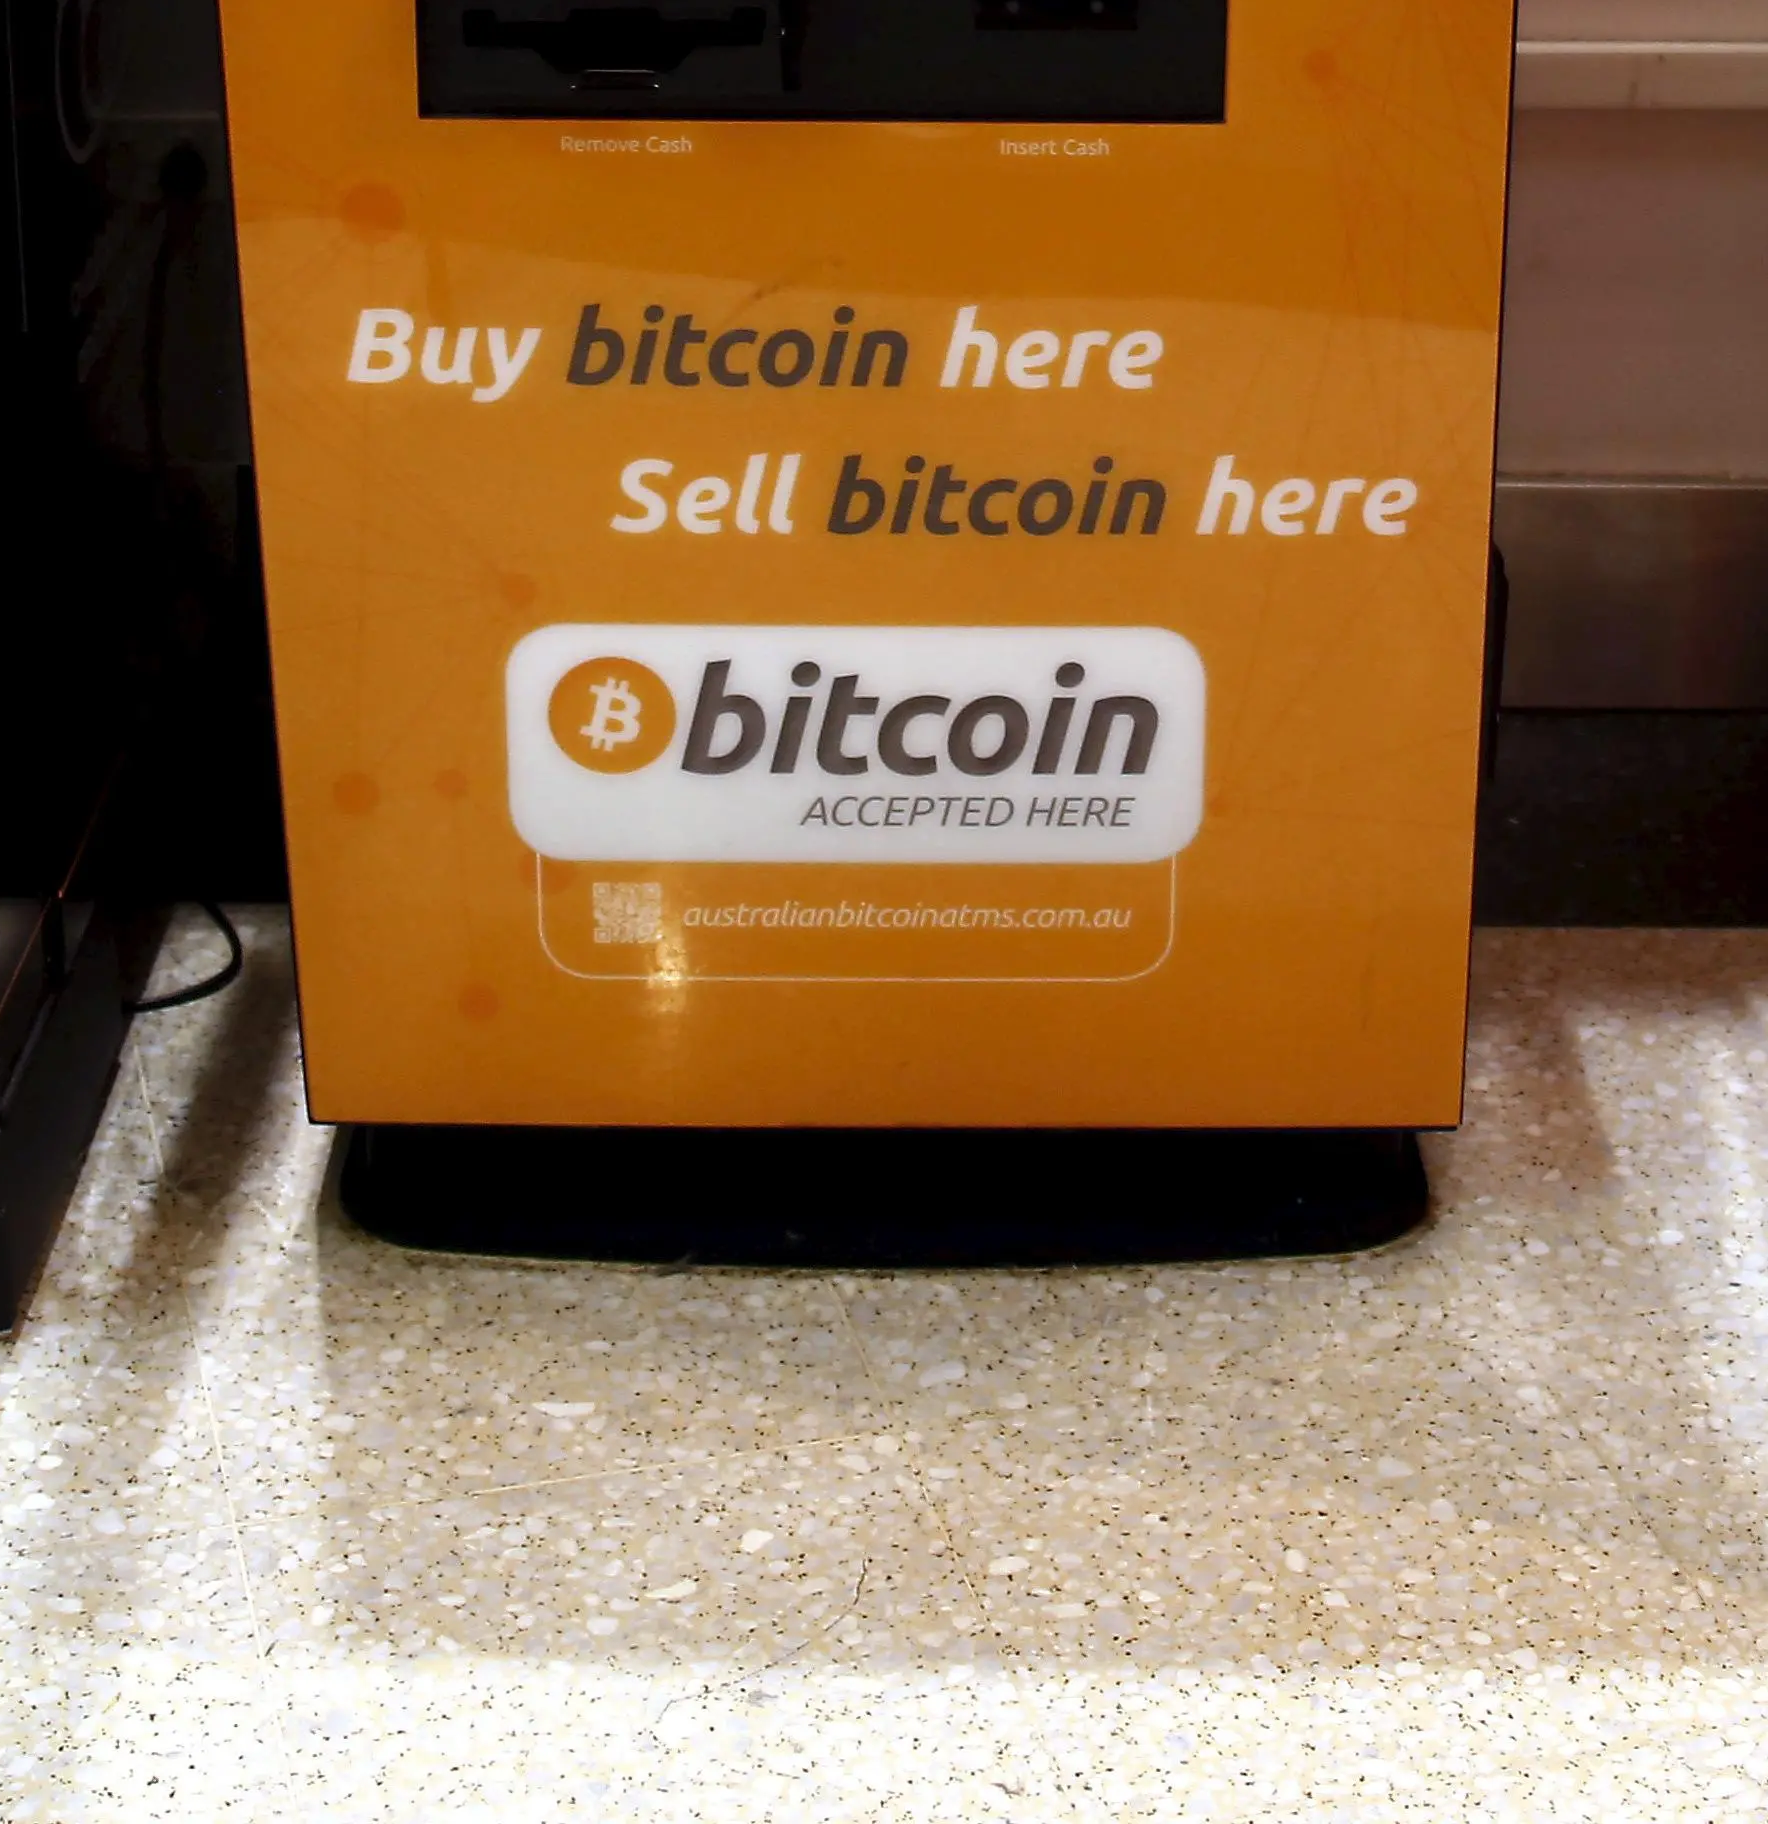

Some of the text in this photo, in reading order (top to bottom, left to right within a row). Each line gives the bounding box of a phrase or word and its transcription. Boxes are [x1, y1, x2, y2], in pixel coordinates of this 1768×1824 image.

[560, 135, 692, 153] Remove Cash
[1000, 138, 1110, 156] Insert Cash
[347, 303, 1164, 404] Buy bitcoin here
[611, 453, 1418, 537] Sell bitcoin here
[681, 659, 1160, 777] bitcoin
[800, 796, 1135, 828] ACCEPTED HERE
[683, 900, 1133, 929] australianbitcoinatms.com.au
